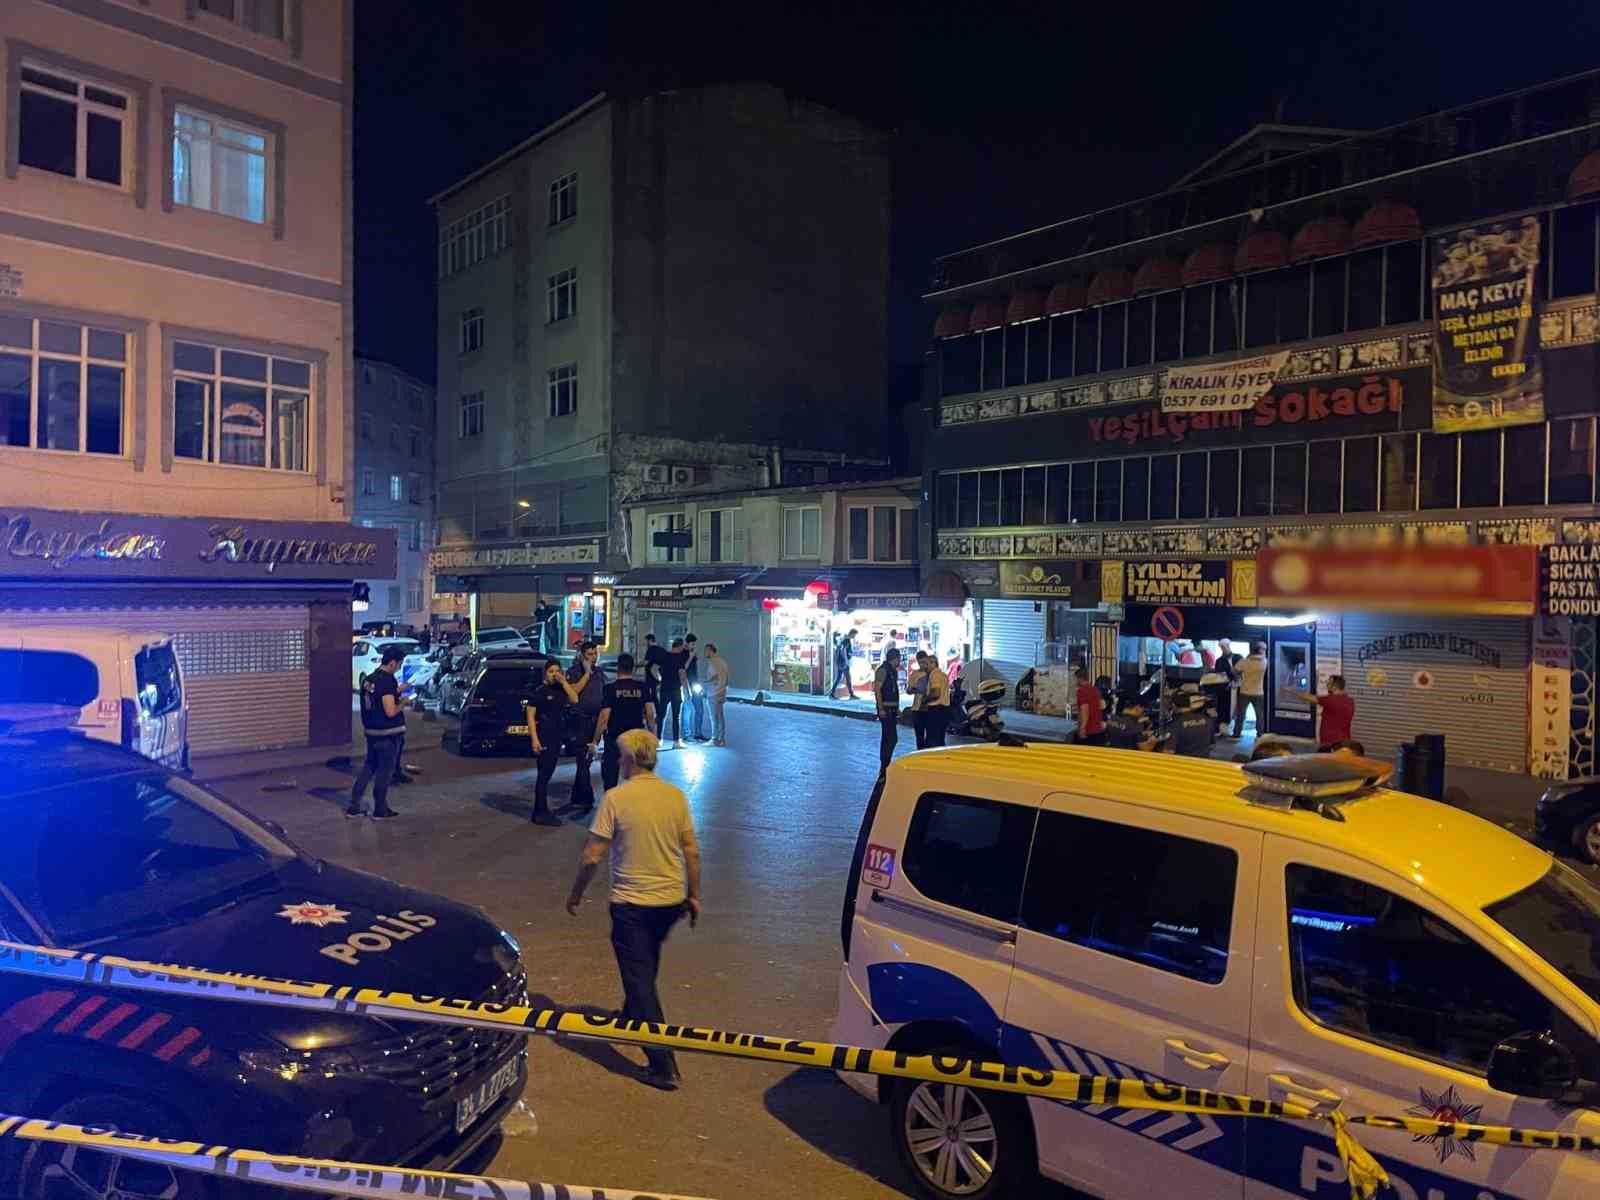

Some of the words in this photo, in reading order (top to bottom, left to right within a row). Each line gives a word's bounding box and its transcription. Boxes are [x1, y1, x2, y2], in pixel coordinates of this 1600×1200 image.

[1440, 289, 1479, 310] MAÇ
[1163, 395, 1197, 407] 0537
[1200, 393, 1225, 407] 691
[1550, 563, 1593, 579] SICAK
[1550, 581, 1594, 597] PASTA
[869, 848, 892, 872] 112
